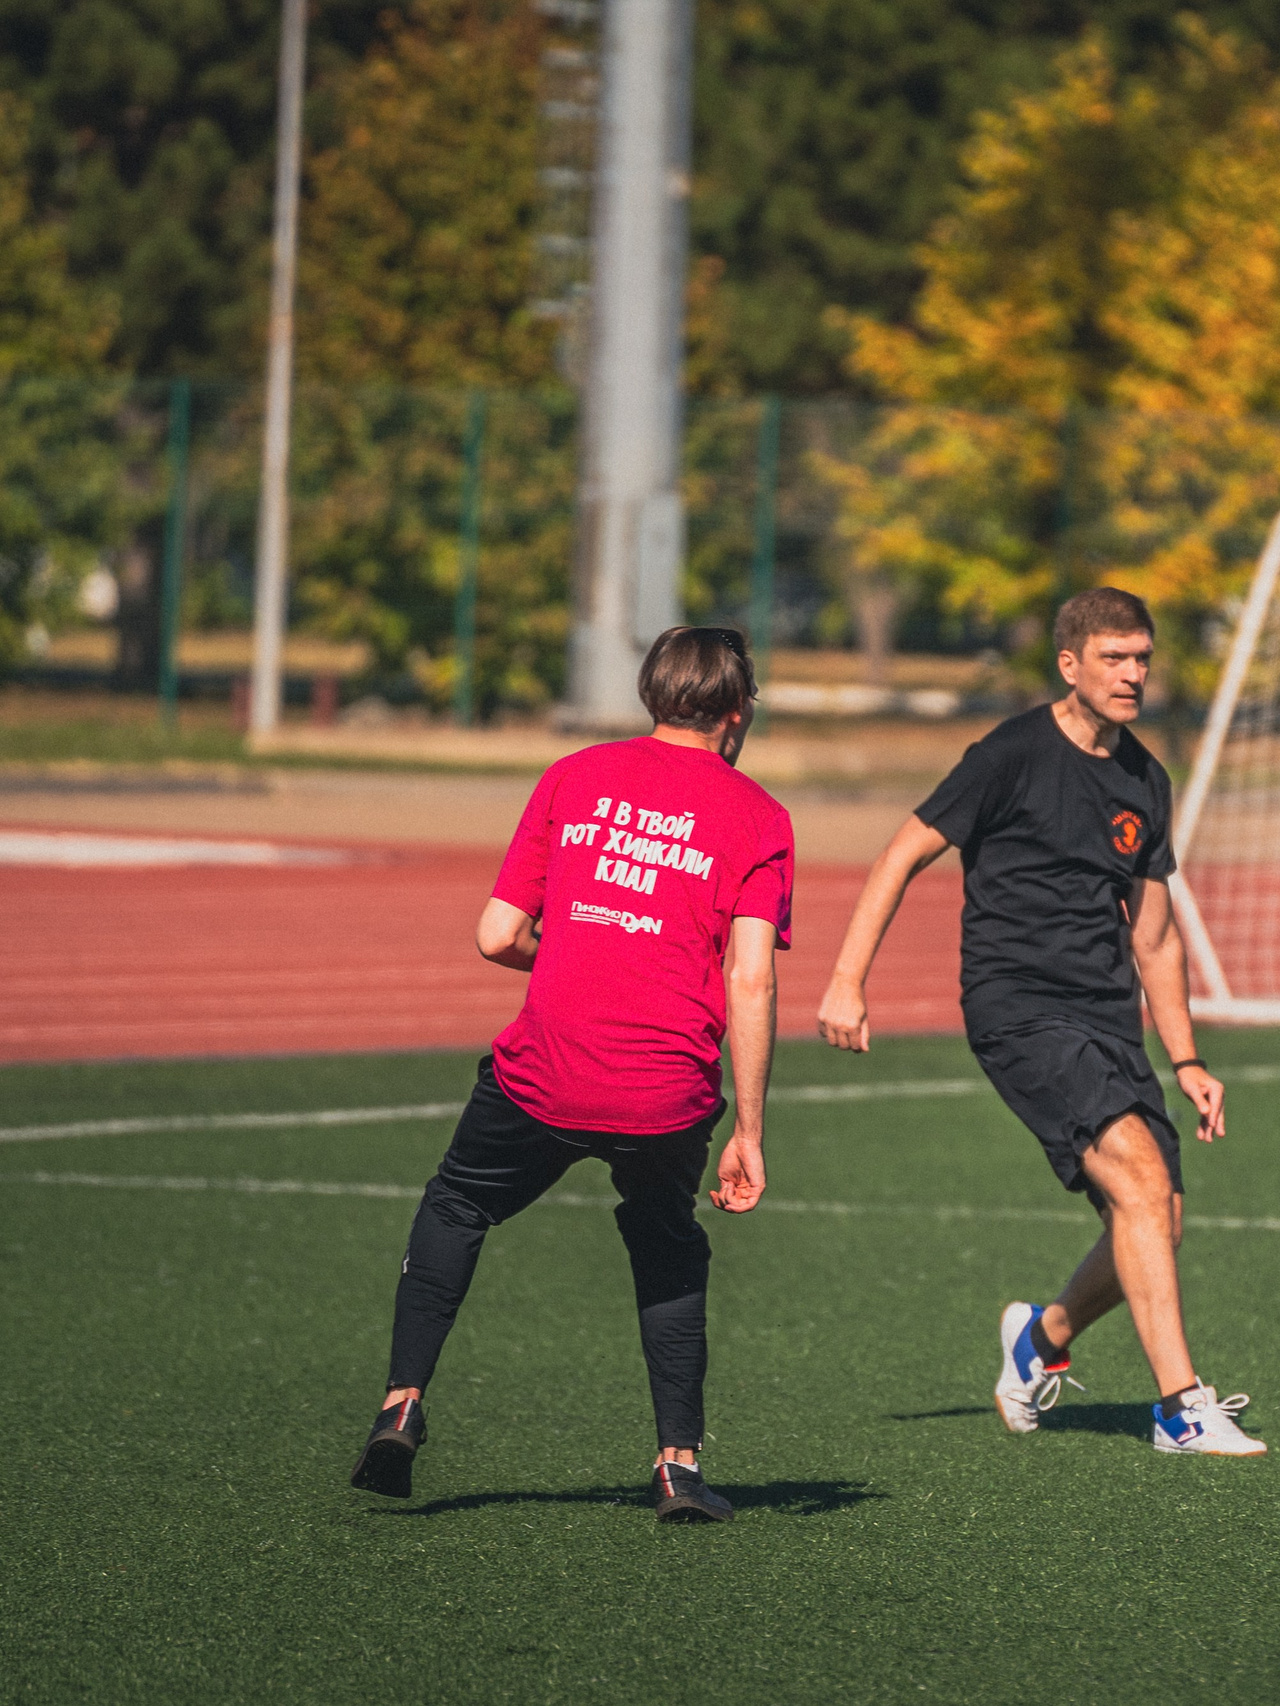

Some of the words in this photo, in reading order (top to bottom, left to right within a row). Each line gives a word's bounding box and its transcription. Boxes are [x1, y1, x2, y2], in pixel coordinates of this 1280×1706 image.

[592, 797, 612, 818] Я
[613, 801, 632, 826] В
[636, 808, 695, 841] ТВОЙ
[561, 823, 601, 847] РОТ
[602, 827, 713, 880] ХИНКАЛИ
[594, 855, 658, 895] КЛАЛ
